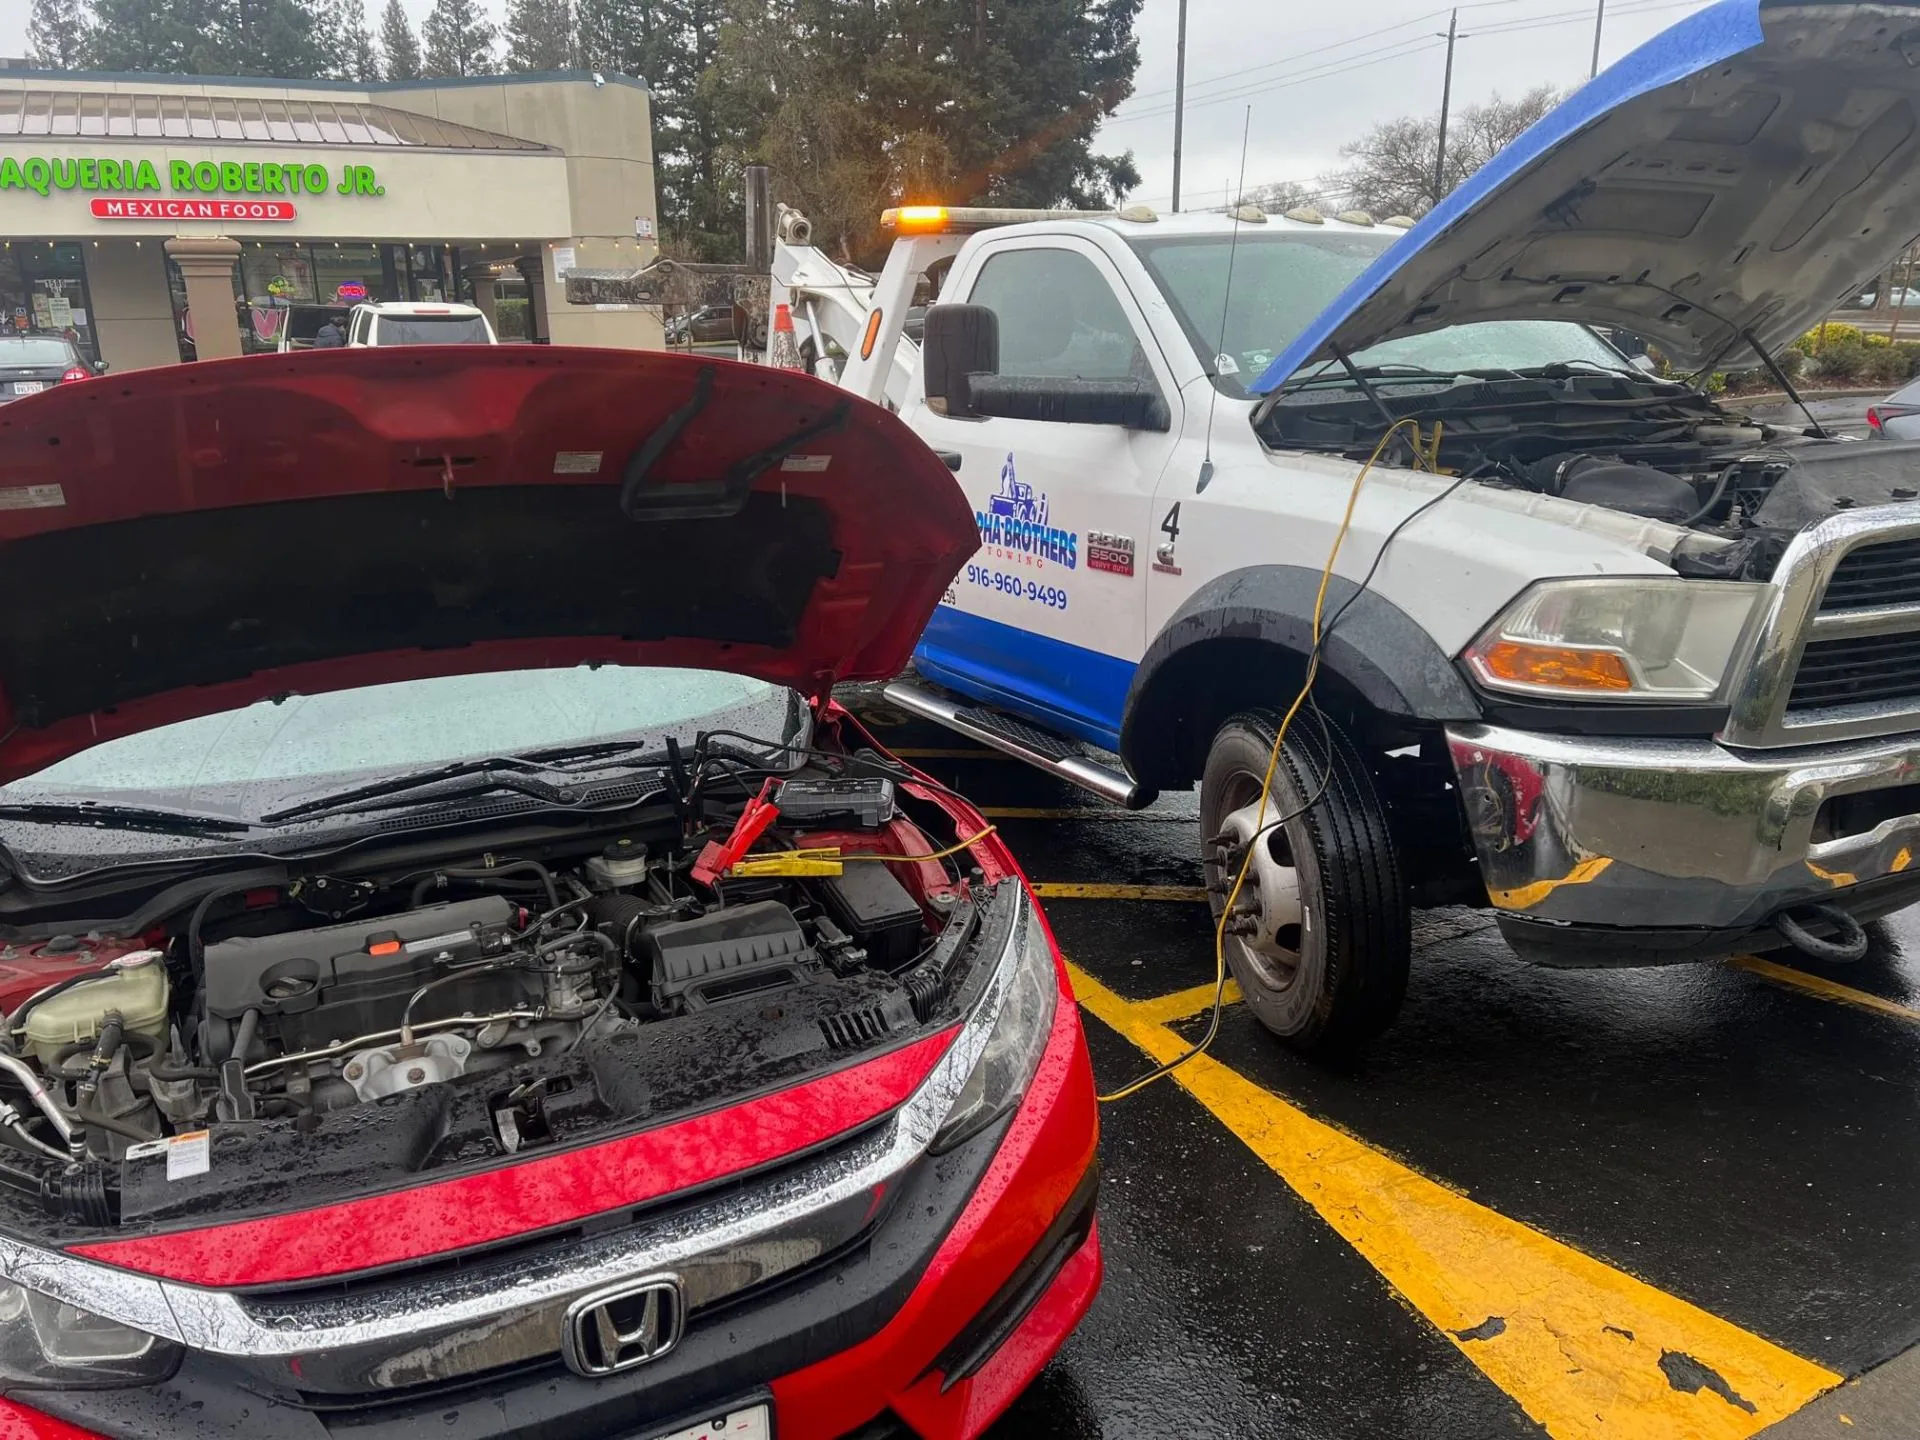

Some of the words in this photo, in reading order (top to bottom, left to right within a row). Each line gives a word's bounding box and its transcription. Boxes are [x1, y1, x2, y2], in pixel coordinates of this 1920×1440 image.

[169, 159, 329, 194] ROBERTO
[336, 164, 385, 195] JR.
[106, 202, 213, 217] MEXICAN
[220, 203, 281, 218] FOOD
[336, 284, 367, 297] OPEN
[1160, 501, 1181, 543] 4
[1003, 516, 1077, 570] BROTHERS
[1087, 530, 1135, 552] RAM
[987, 546, 1043, 568] TOWING
[1090, 548, 1130, 565] 5500
[967, 564, 1068, 610] 916-960-9499
